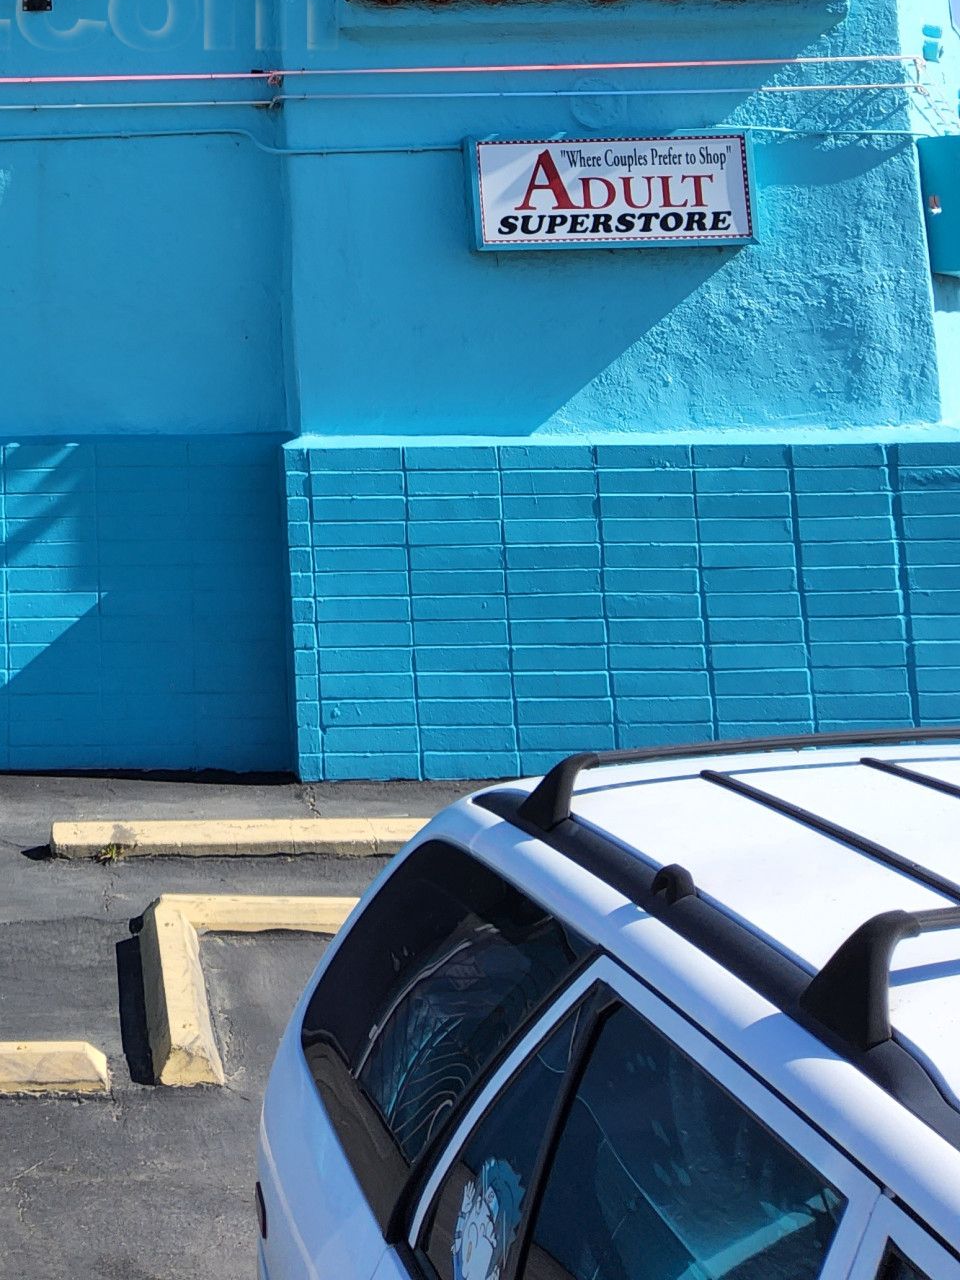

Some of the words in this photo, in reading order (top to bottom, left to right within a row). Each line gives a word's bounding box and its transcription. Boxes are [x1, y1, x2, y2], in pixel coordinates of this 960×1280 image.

[560, 150, 602, 168] "Where
[604, 148, 648, 172] Couples
[650, 147, 682, 166] Prefer
[685, 153, 696, 165] to
[699, 145, 732, 170] Shop"
[514, 148, 714, 211] ADULT
[498, 210, 732, 235] SUPERSTORE
